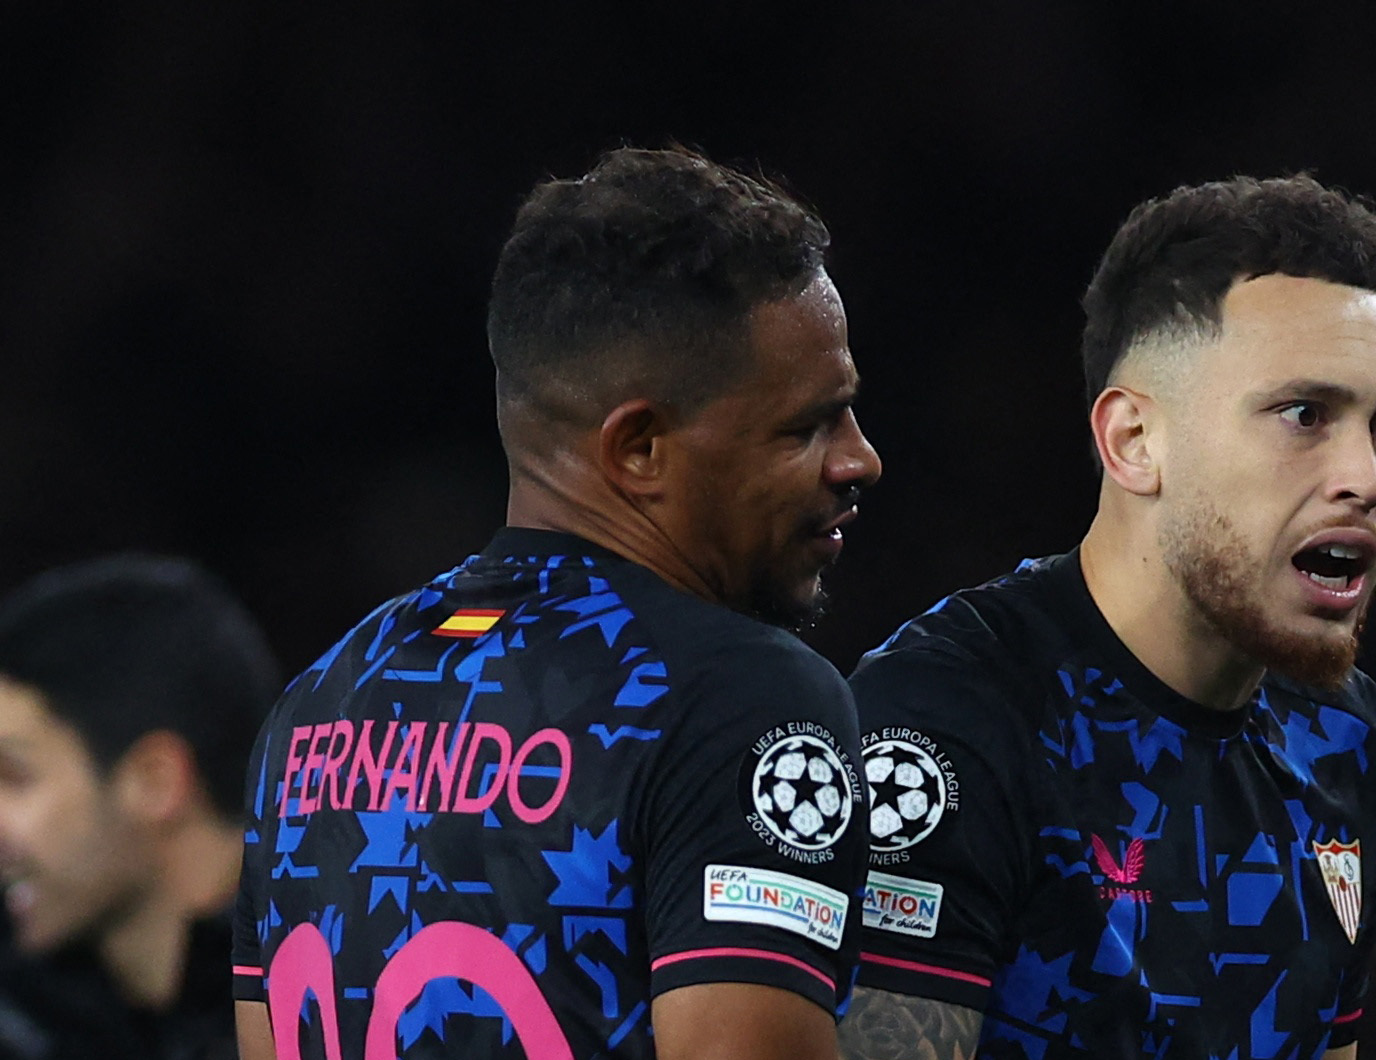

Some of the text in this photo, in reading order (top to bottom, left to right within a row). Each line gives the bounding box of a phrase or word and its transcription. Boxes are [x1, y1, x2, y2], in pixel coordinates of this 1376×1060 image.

[278, 719, 572, 824] FERNANDO
[751, 721, 863, 803] UEFA EUROPA LEAGUE
[860, 727, 960, 812] FA EUROPA LEAGUE
[745, 811, 835, 865] 2023 WINNERS
[709, 868, 748, 881] UEFA
[878, 913, 933, 933] for children
